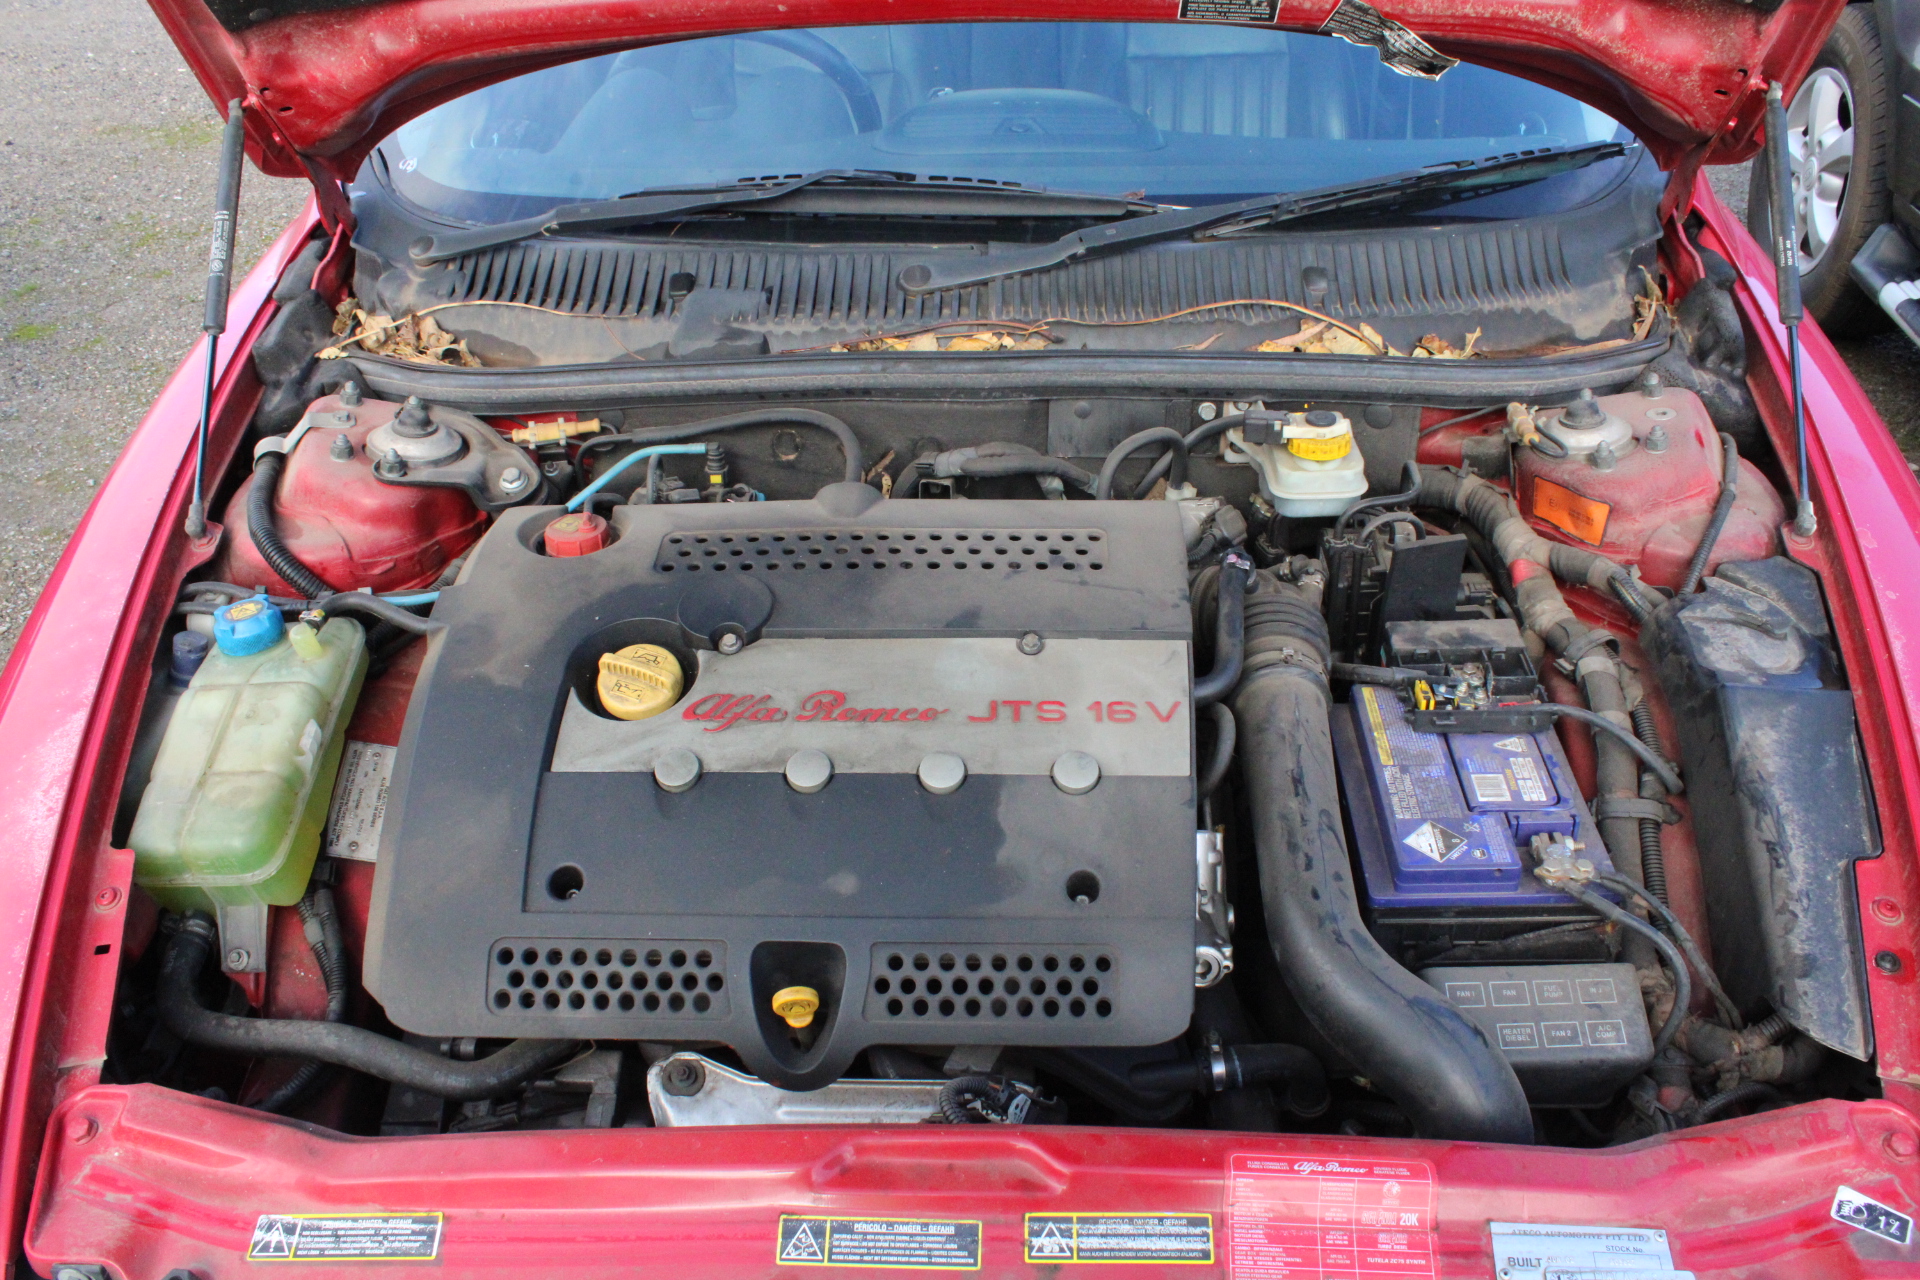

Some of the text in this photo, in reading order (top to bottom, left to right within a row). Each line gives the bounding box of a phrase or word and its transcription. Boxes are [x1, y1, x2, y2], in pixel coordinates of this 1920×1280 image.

[682, 694, 788, 732] Alfa
[795, 690, 949, 723] Romeo
[967, 700, 1067, 722] JTS
[1294, 1162, 1369, 1174] Alfa Romeo
[1400, 1213, 1419, 1226] 20K
[854, 1223, 955, 1234] PERICOLO DANGER GEFAHR
[1544, 1231, 1602, 1240] AUTOMOTIVE
[1508, 1257, 1542, 1267] BUILT
